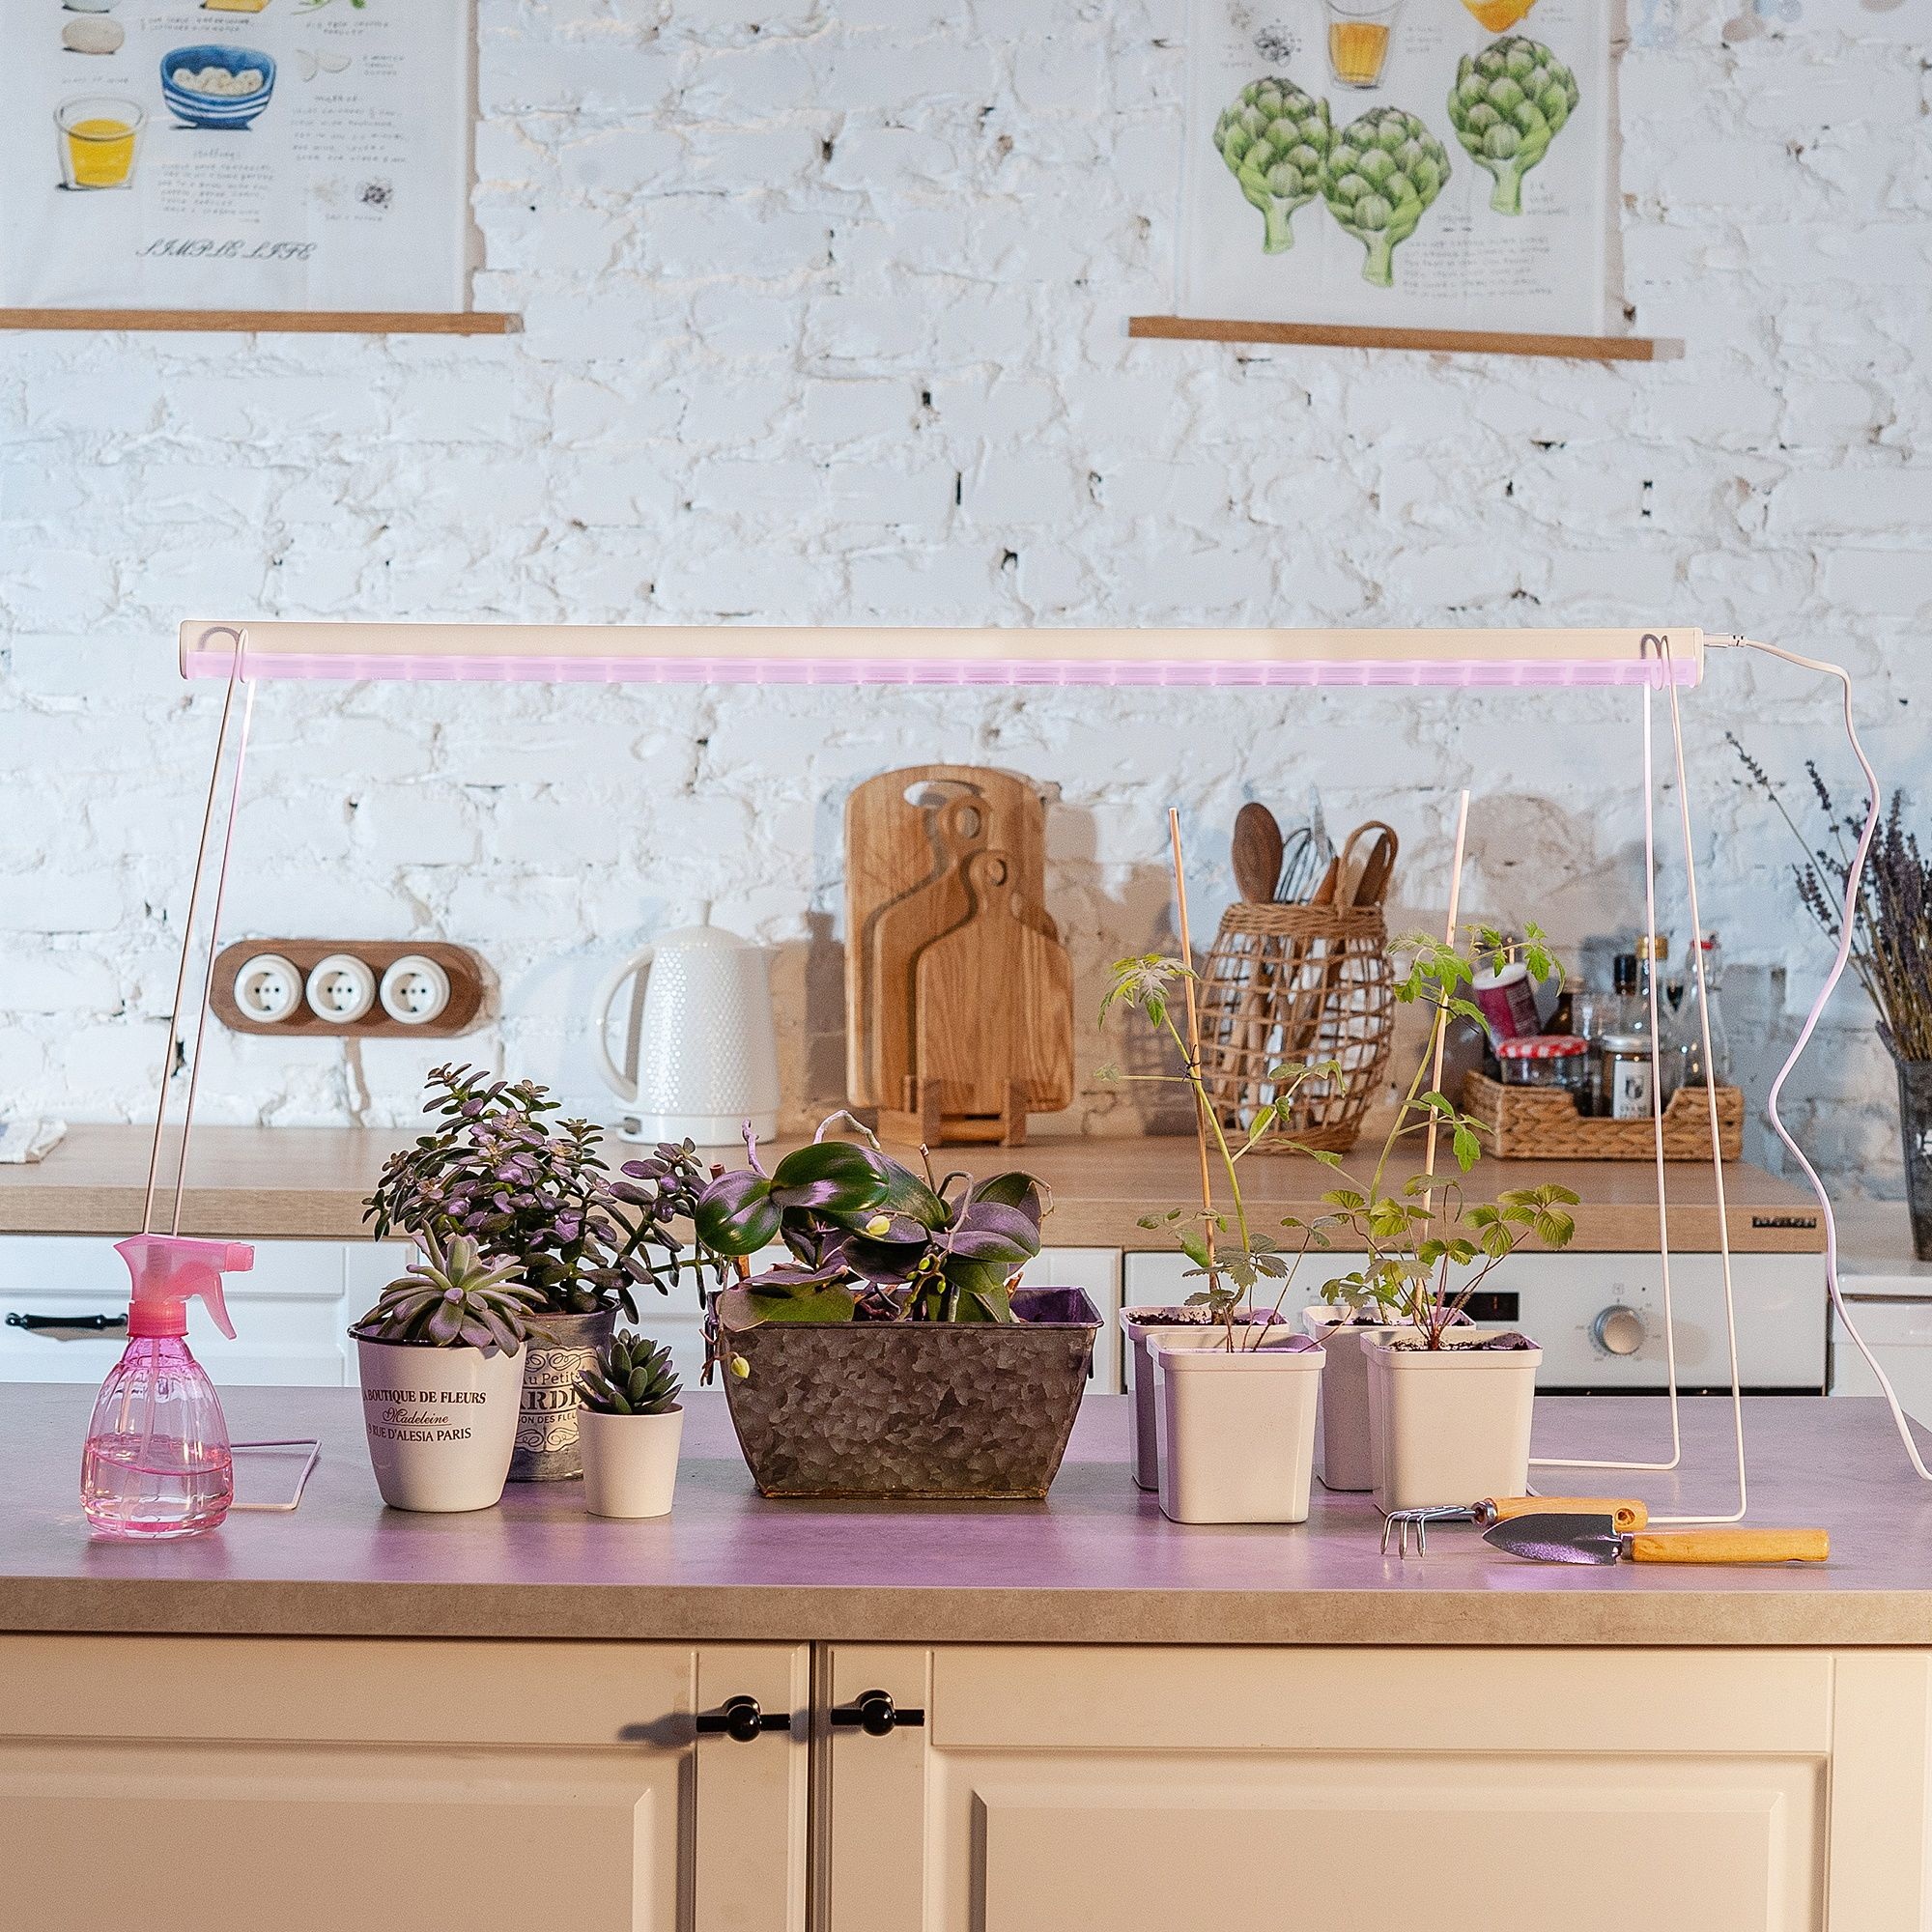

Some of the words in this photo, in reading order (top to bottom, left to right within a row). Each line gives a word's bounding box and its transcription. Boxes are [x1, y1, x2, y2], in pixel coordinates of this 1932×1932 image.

[135, 239, 244, 258] SIMPLE
[242, 242, 317, 261] LIFE
[541, 1372, 575, 1385] Petit
[367, 1389, 416, 1405] BOUTIQUE
[419, 1391, 438, 1403] DE
[440, 1391, 487, 1405] FLEURS
[382, 1406, 449, 1425] Madeleine
[537, 1415, 555, 1424] DES
[372, 1425, 386, 1438] RUE
[388, 1428, 434, 1442] D'ALESIA
[437, 1427, 471, 1441] PARIS
